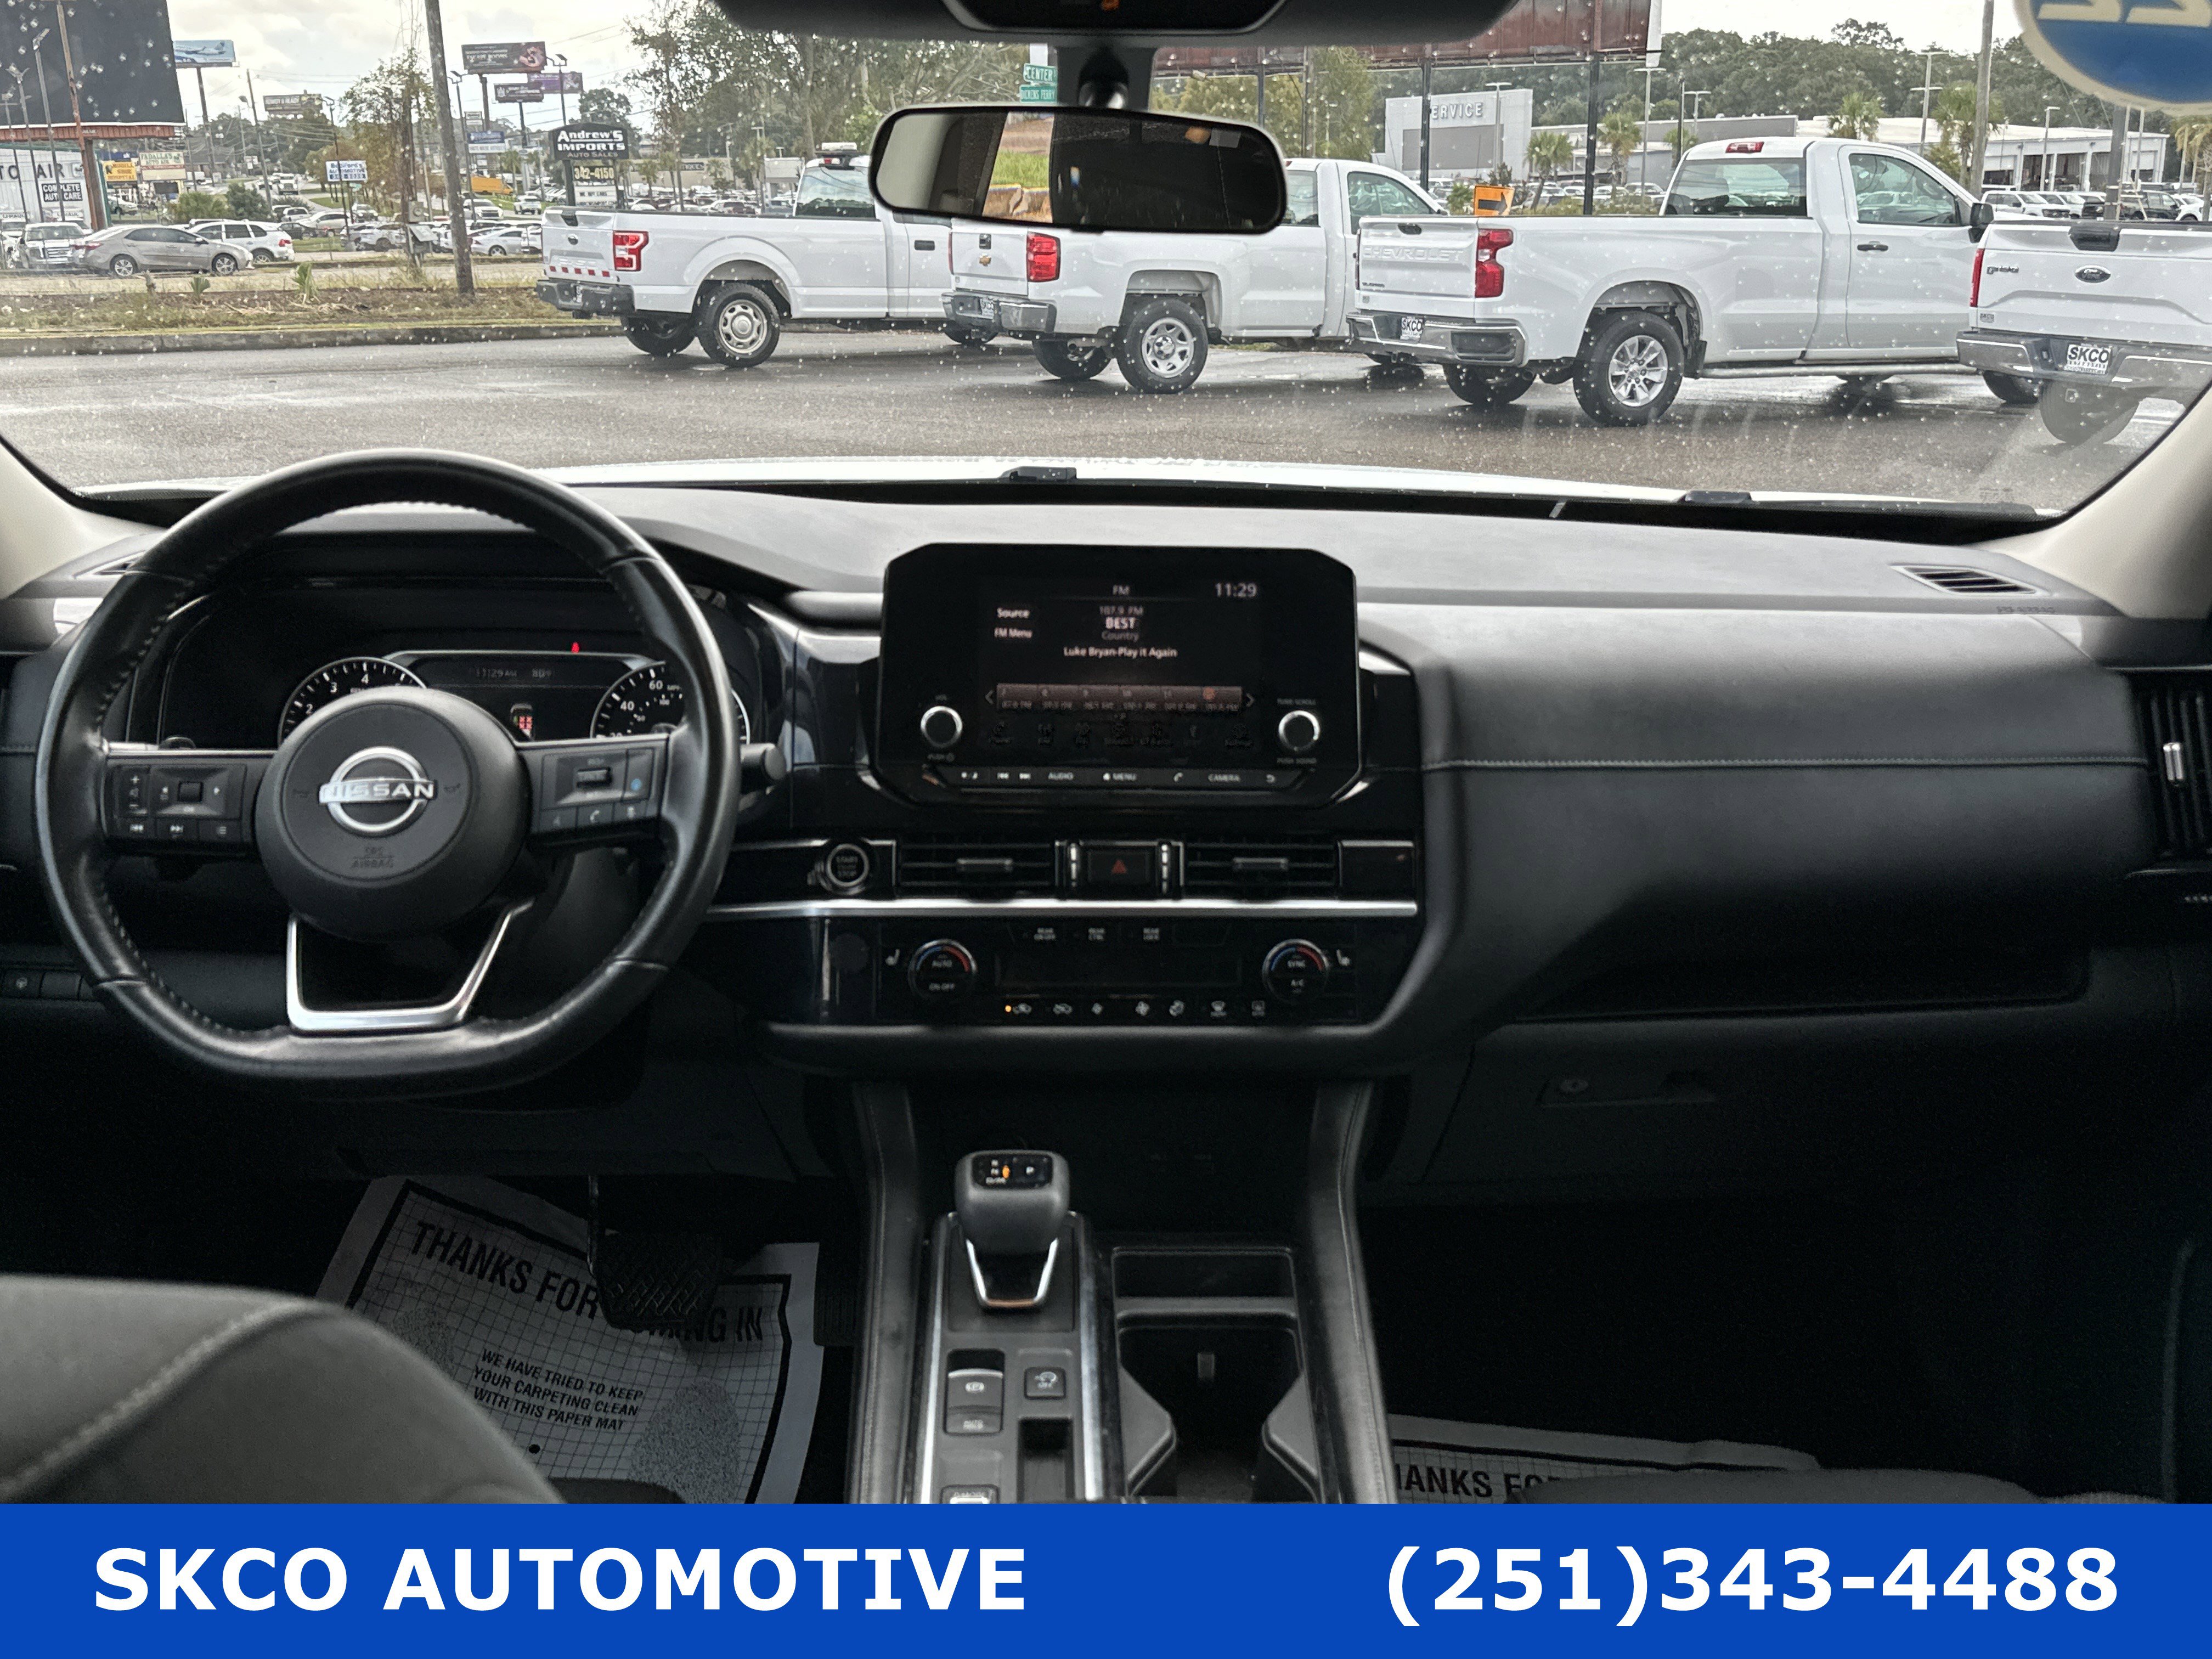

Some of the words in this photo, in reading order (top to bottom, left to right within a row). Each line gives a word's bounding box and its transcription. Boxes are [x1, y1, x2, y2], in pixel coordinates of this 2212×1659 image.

[1025, 66, 1053, 81] CENTER
[1430, 102, 1482, 119] ERVICE
[37, 163, 65, 178] AIR
[574, 166, 614, 179] 342-4150
[43, 183, 81, 192] COMLETE
[44, 192, 61, 200] AUT
[1363, 247, 1464, 261] CHEVROLET
[1401, 317, 1423, 331] SKCO
[2068, 347, 2109, 363] SKCO
[1112, 584, 1130, 596] FM
[1215, 582, 1257, 599] 11:29
[997, 607, 1030, 619] Source
[1127, 606, 1144, 616] FM
[1105, 617, 1137, 630] BEST
[994, 627, 1008, 638] FM
[1009, 628, 1033, 639] Menu
[1101, 631, 1139, 642] Country
[1063, 646, 1087, 657] Luke
[1139, 647, 1147, 657] it
[1148, 647, 1178, 659] Again
[361, 674, 370, 684] 4
[649, 680, 663, 690] 60
[330, 682, 338, 693] 3
[306, 704, 314, 714] 2
[620, 701, 635, 711] 40
[1047, 772, 1074, 780] AUDIO
[1111, 772, 1137, 781] MENU
[1207, 774, 1240, 782] CAMERA
[322, 783, 435, 799] NISSAN
[1025, 1166, 1035, 1175] P
[412, 1220, 533, 1294] THANKS
[535, 1270, 600, 1320] FOR
[736, 1307, 763, 1342] IN
[481, 1347, 504, 1367] WE
[505, 1357, 542, 1380] HAVE
[545, 1369, 583, 1391] TRIED
[589, 1381, 605, 1395] TO
[608, 1385, 644, 1401] KEEP
[474, 1364, 511, 1390] YOUR
[514, 1380, 591, 1410] CARPETING
[594, 1400, 638, 1416] CLEAN
[473, 1386, 510, 1410] WITH
[513, 1398, 545, 1418] THIS
[548, 1408, 593, 1427] PAPER
[595, 1417, 626, 1431] MAT
